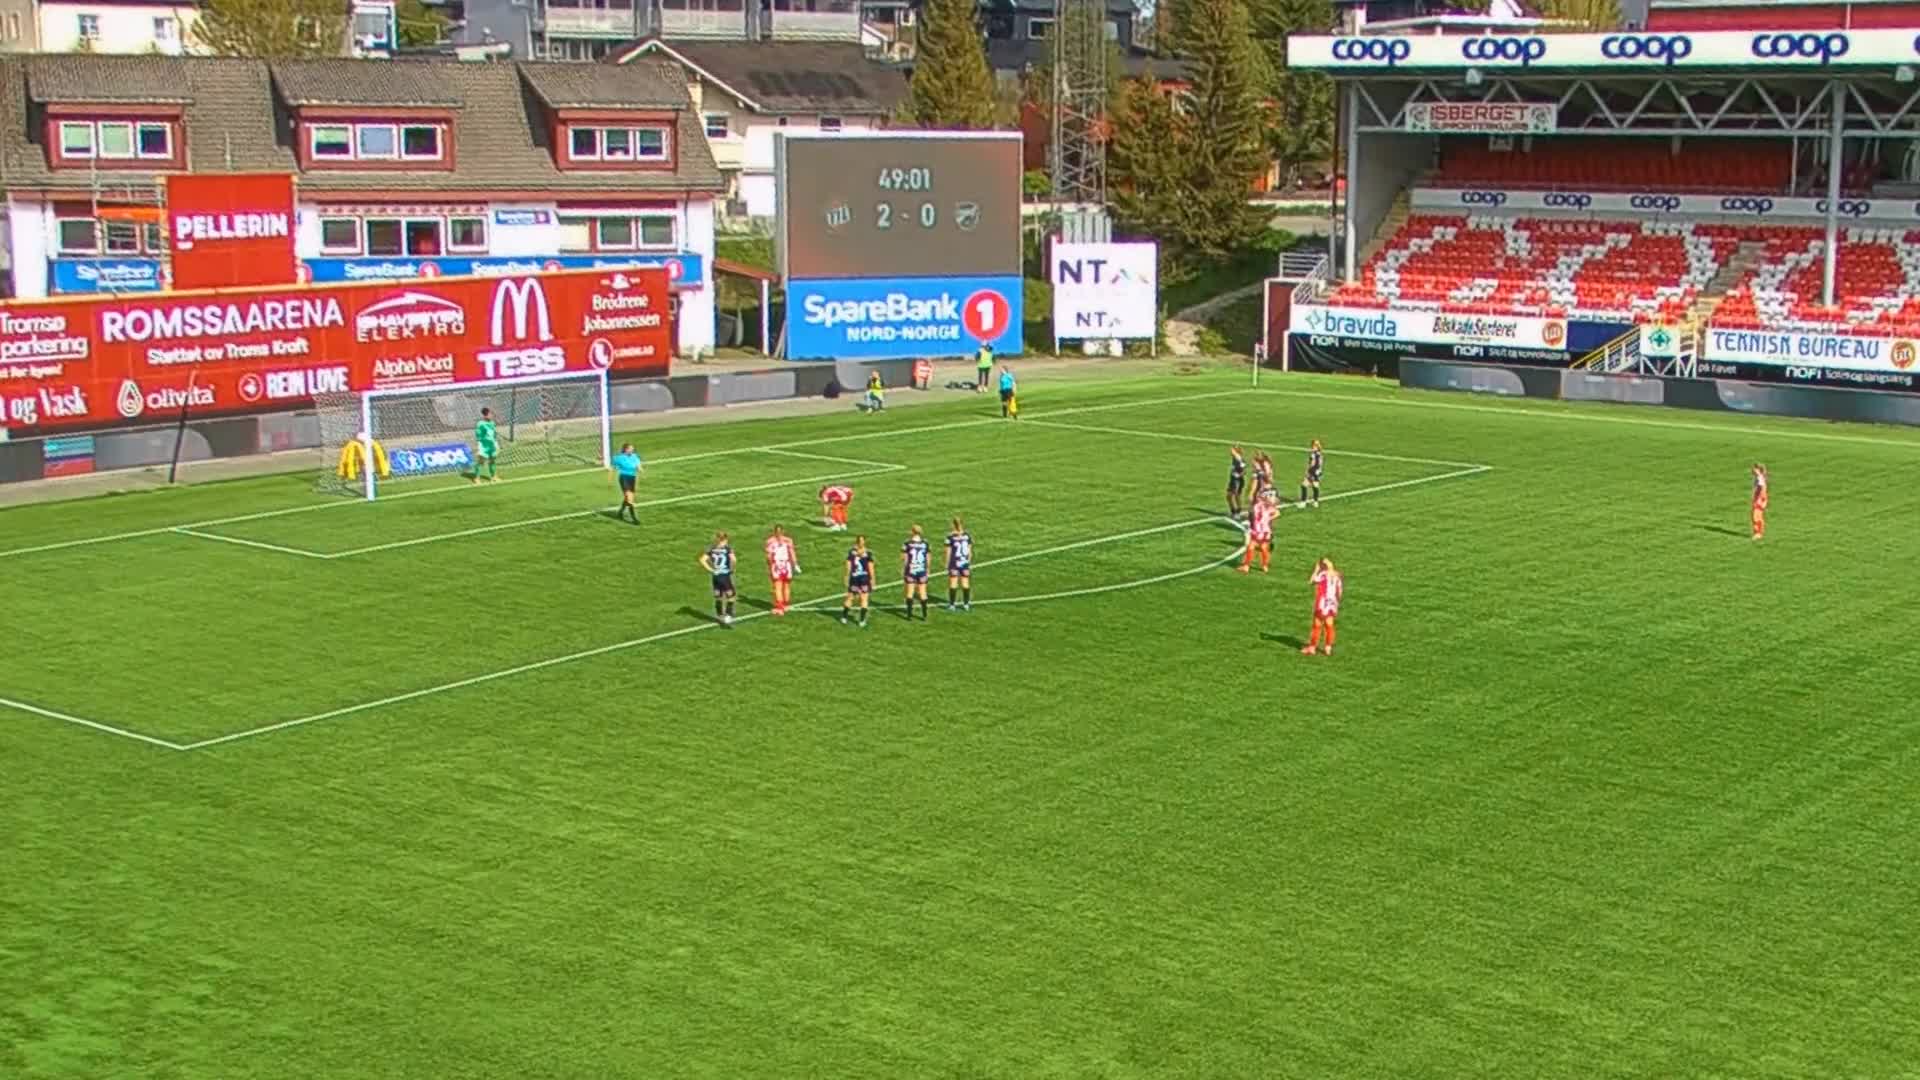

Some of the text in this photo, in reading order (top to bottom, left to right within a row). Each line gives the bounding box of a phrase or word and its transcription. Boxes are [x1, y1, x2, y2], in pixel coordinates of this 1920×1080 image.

[1332, 39, 1410, 66] coop
[1462, 37, 1546, 66] coop
[1601, 35, 1692, 65] coop
[1752, 33, 1849, 64] coop
[1430, 104, 1529, 121] ISBERGET
[879, 168, 931, 189] 49:01
[1461, 191, 1507, 207] coop
[1543, 193, 1592, 210] coop
[1630, 195, 1681, 212] coop
[1721, 198, 1773, 215] coop
[1816, 200, 1870, 218] cop
[175, 213, 288, 240] PELLERIN
[877, 203, 892, 227] 2
[921, 203, 935, 227] 0
[804, 292, 995, 331] SpareBank 1
[1325, 311, 1397, 336] bravida
[356, 321, 465, 342] ELEKTRO
[847, 325, 960, 342] NORD-NORGE
[205, 347, 225, 361] av
[272, 338, 310, 355] Kraft
[1713, 331, 1880, 360] TEKNISK BUREAU
[373, 351, 454, 378] Alpha Nord
[477, 346, 566, 378] TESS
[266, 372, 306, 398] REIN
[307, 367, 349, 394] LOVE
